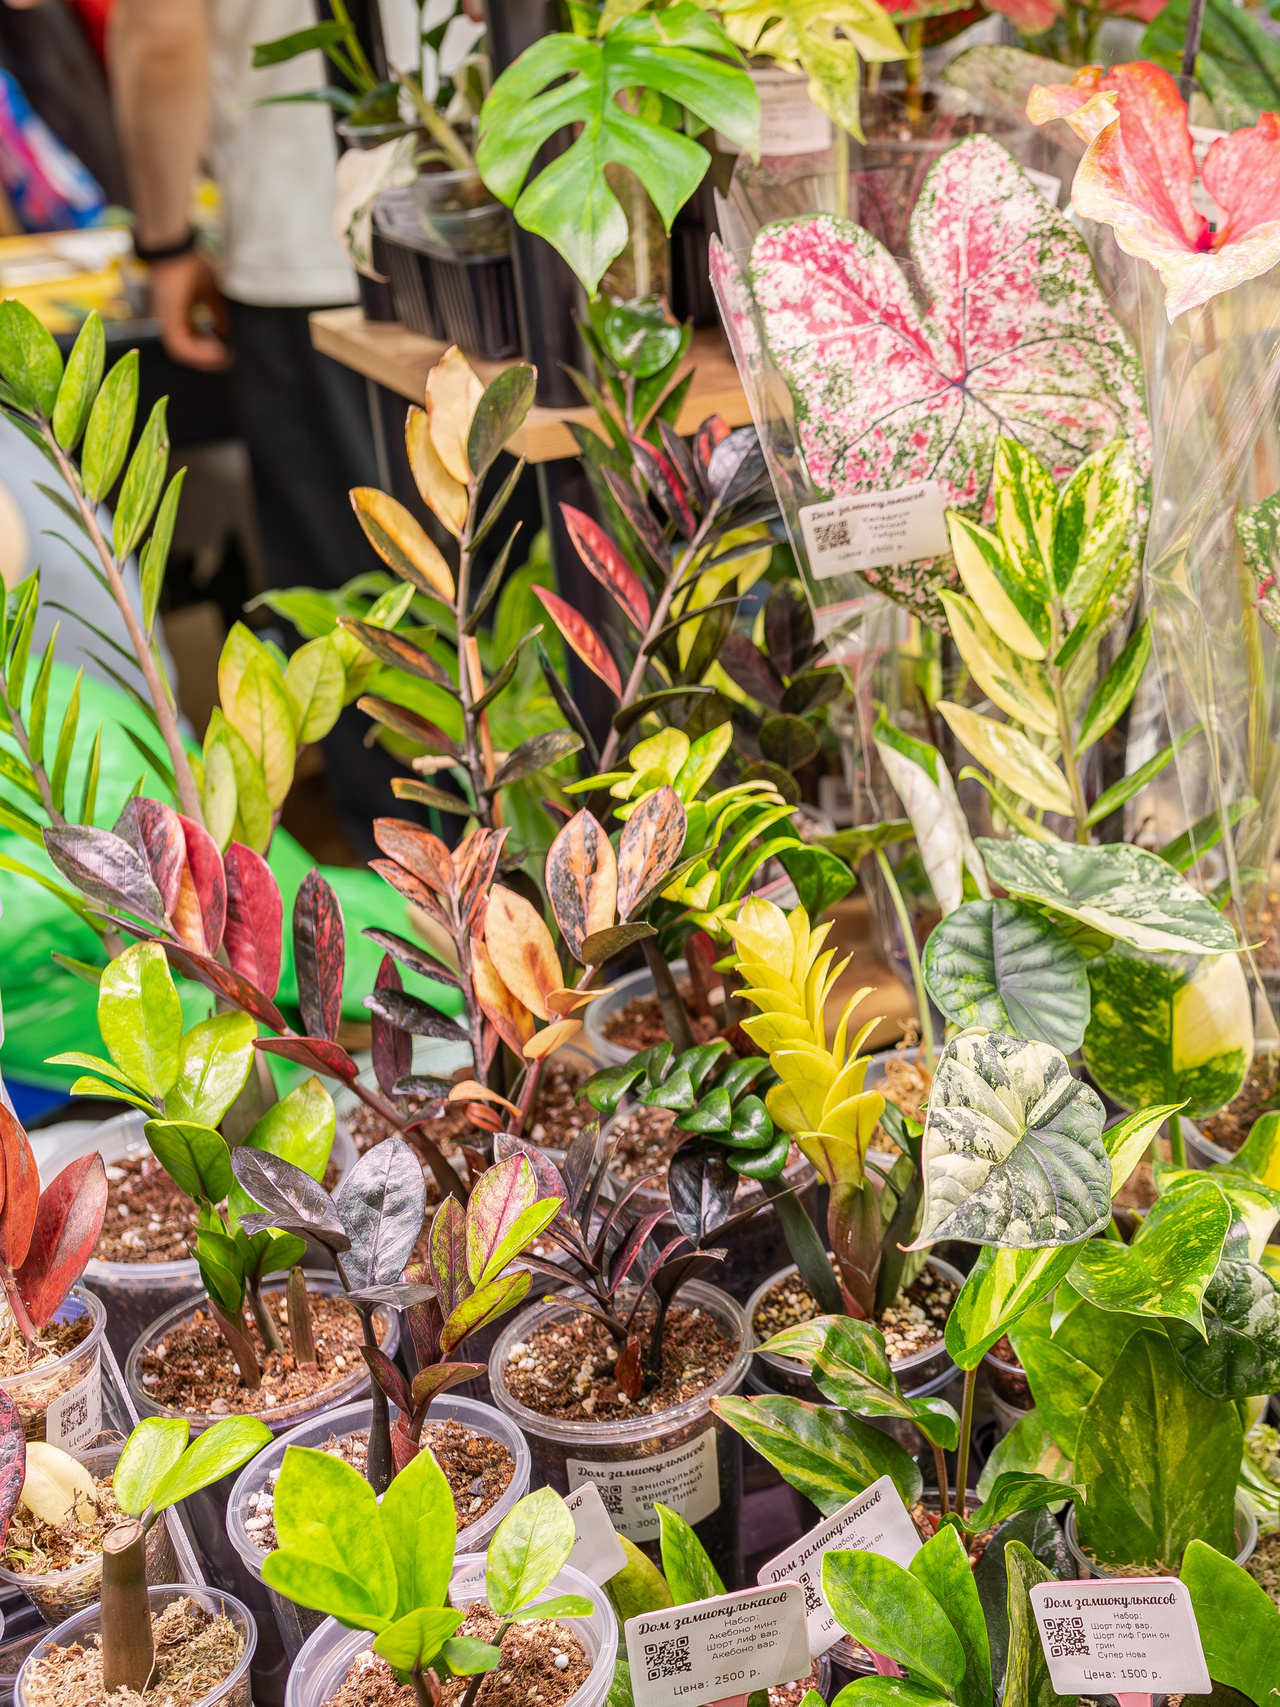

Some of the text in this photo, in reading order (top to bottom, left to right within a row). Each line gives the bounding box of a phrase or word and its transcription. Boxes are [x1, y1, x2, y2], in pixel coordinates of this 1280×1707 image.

[577, 1467, 605, 1478] Дом
[631, 1461, 704, 1493] Замиокулькас
[636, 1518, 661, 1529] 300
[770, 1490, 882, 1583] Дом замиокулькасов
[852, 1536, 868, 1548] вар.
[874, 1533, 884, 1542] он
[1043, 1593, 1177, 1610] Дом замиокулькасов
[638, 1592, 789, 1635] Дом замиокулькасов
[1113, 1612, 1142, 1621] Набор:
[724, 1614, 759, 1627] Набор:
[1091, 1622, 1152, 1631] Шорт лиф вар.
[708, 1619, 778, 1641] Акебоно минт
[1093, 1632, 1115, 1640] Шорт
[1117, 1632, 1134, 1640] лиф
[1137, 1632, 1157, 1640] Грин
[706, 1630, 781, 1652] Шорт лиф вар.
[1095, 1642, 1115, 1650] грин
[711, 1641, 778, 1660] Акебоно вар.
[1097, 1652, 1124, 1660] Супер
[1084, 1669, 1162, 1681] Цена: 1500 р.
[673, 1669, 760, 1696] Цена: 2500 р.
